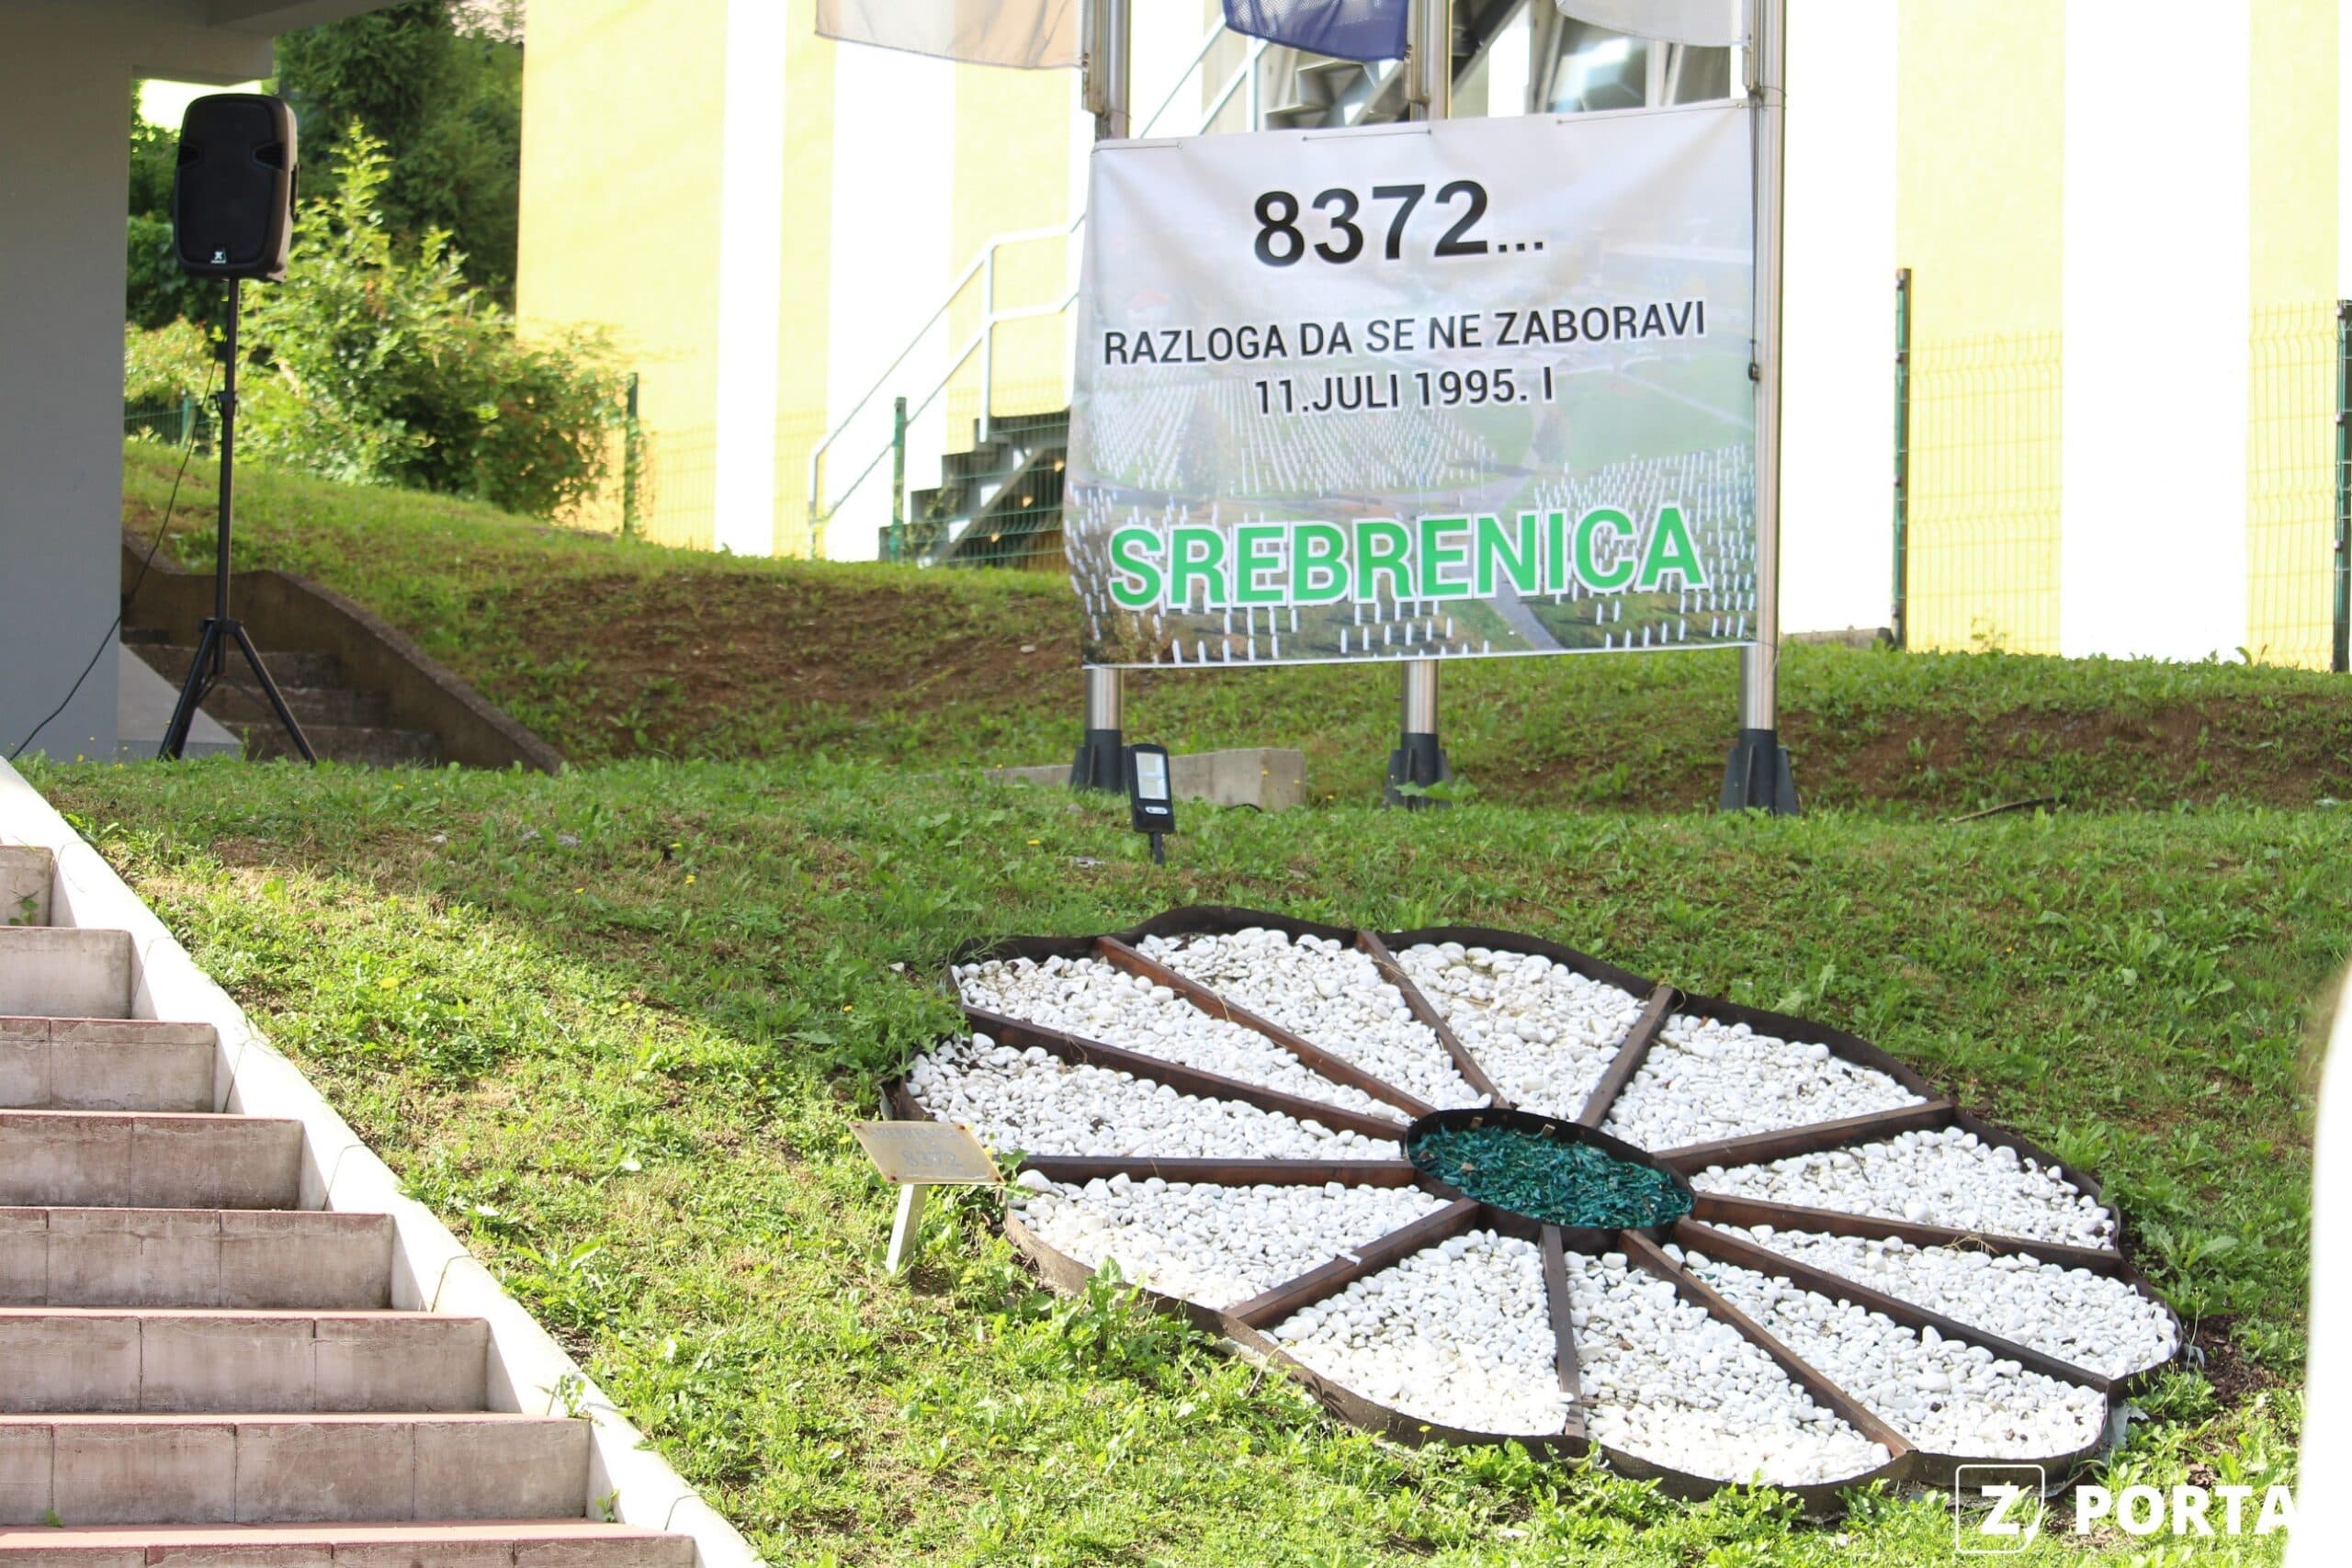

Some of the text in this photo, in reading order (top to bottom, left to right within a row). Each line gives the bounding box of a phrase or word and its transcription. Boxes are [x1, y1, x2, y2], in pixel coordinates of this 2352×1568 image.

[1253, 179, 1544, 265] 8372...
[1104, 299, 1704, 366] RAZLOGA DA SE NE ZABORAVI
[1255, 373, 1399, 414] 11.JULI
[1415, 367, 1528, 407] 1995.
[1110, 506, 1705, 608] SREBRENICA
